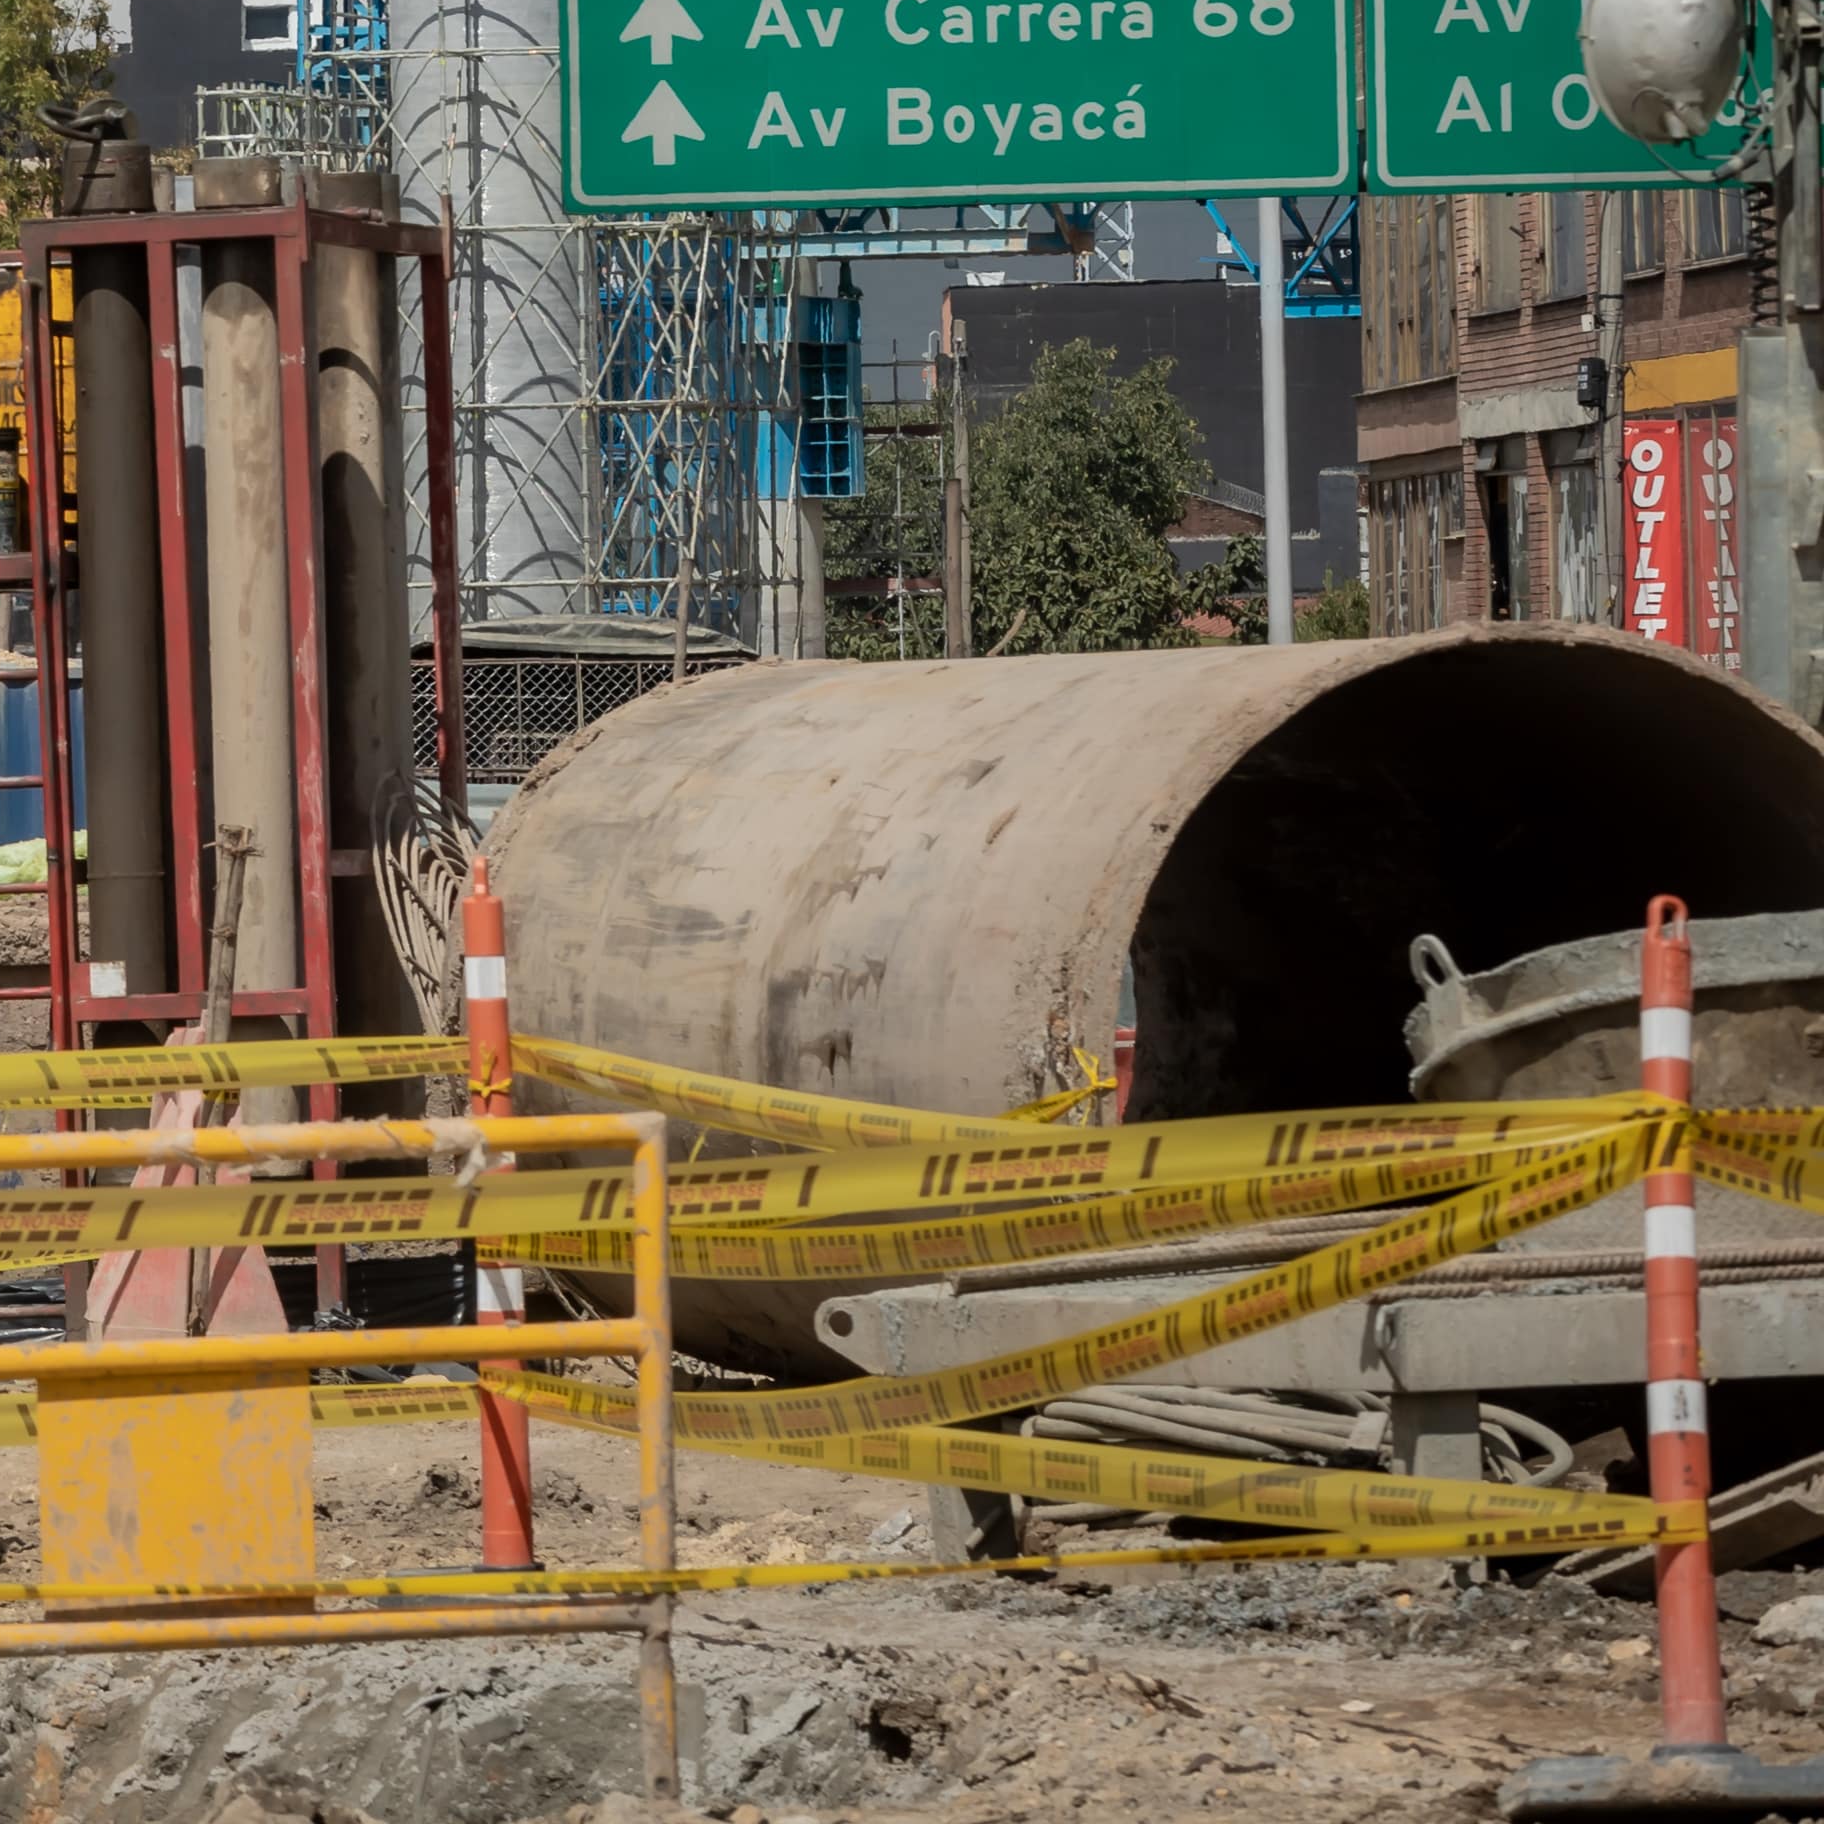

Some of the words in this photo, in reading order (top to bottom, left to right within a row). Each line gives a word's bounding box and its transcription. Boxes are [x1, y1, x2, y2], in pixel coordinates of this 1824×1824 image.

[747, 91, 846, 149] Av
[886, 84, 1147, 156] Boyacá
[1436, 75, 1513, 133] Al
[1630, 439, 1668, 640] OUTLET
[19, 1213, 44, 1230] NO
[48, 1211, 90, 1229] PASE
